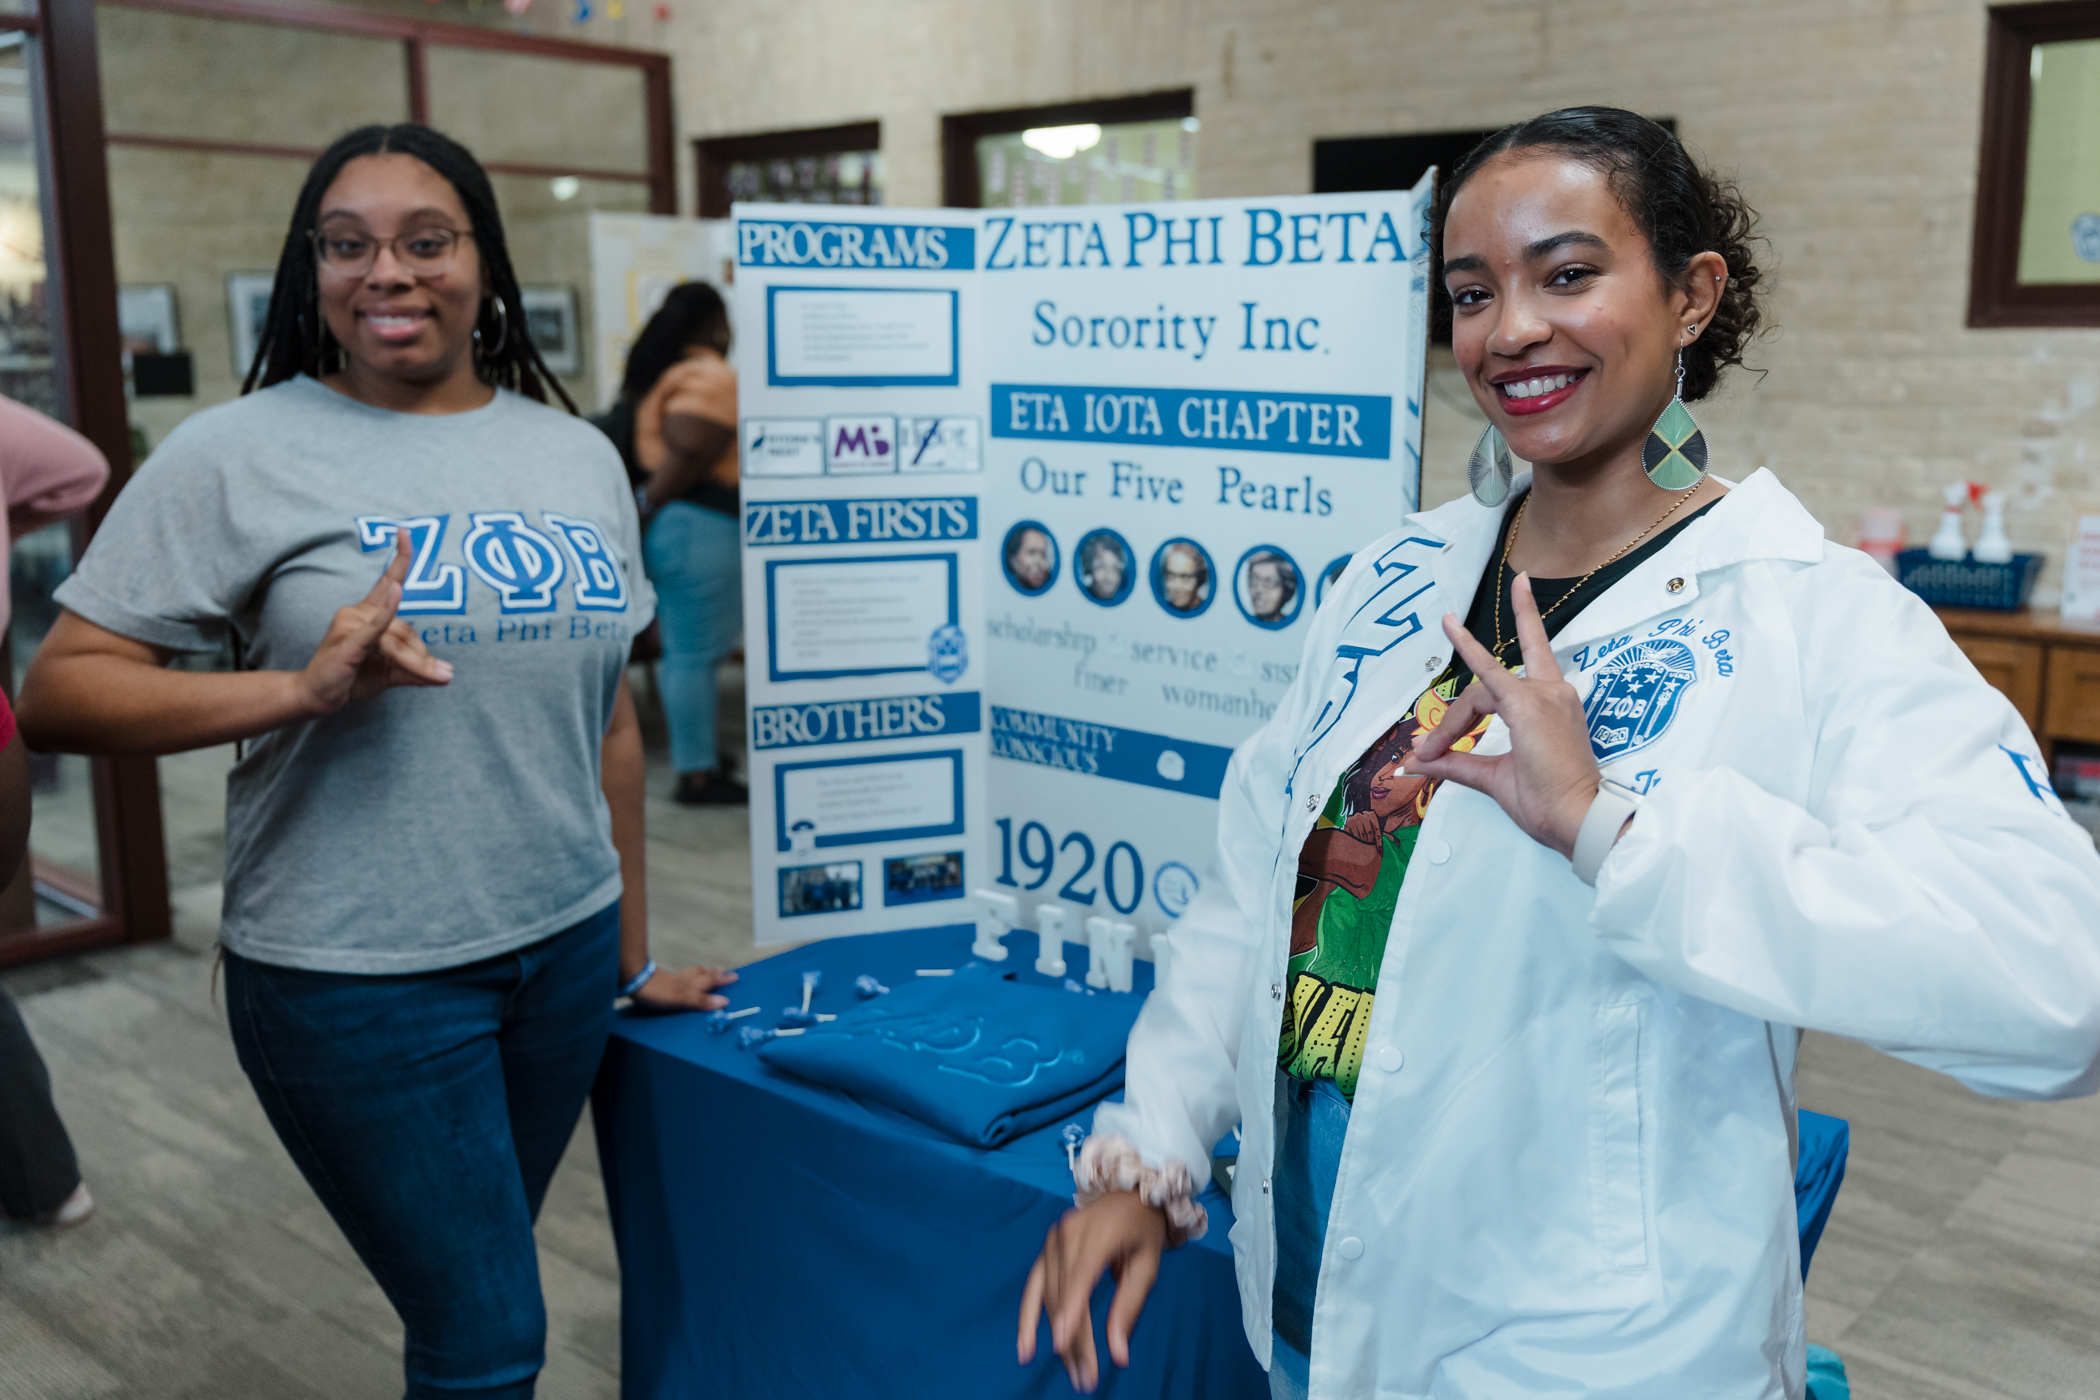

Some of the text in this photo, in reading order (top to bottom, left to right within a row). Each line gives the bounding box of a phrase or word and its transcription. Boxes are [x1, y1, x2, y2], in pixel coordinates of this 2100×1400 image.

[739, 222, 948, 268] PROGRAMS
[984, 208, 1408, 270] ZETA PHI BETA
[1032, 300, 1330, 361] Sorority Inc.
[1009, 391, 1363, 447] ETA IOTA CHAPTER
[1021, 456, 1332, 516] Our Five Pearls
[747, 499, 968, 544] ZETA FIRSTS
[412, 620, 476, 644] eta
[498, 616, 551, 643] Phi
[1131, 642, 1218, 673] service
[1573, 618, 1733, 677] Zeta Phi Beta
[755, 695, 945, 747] BROTHERS
[995, 816, 1143, 914] 1920
